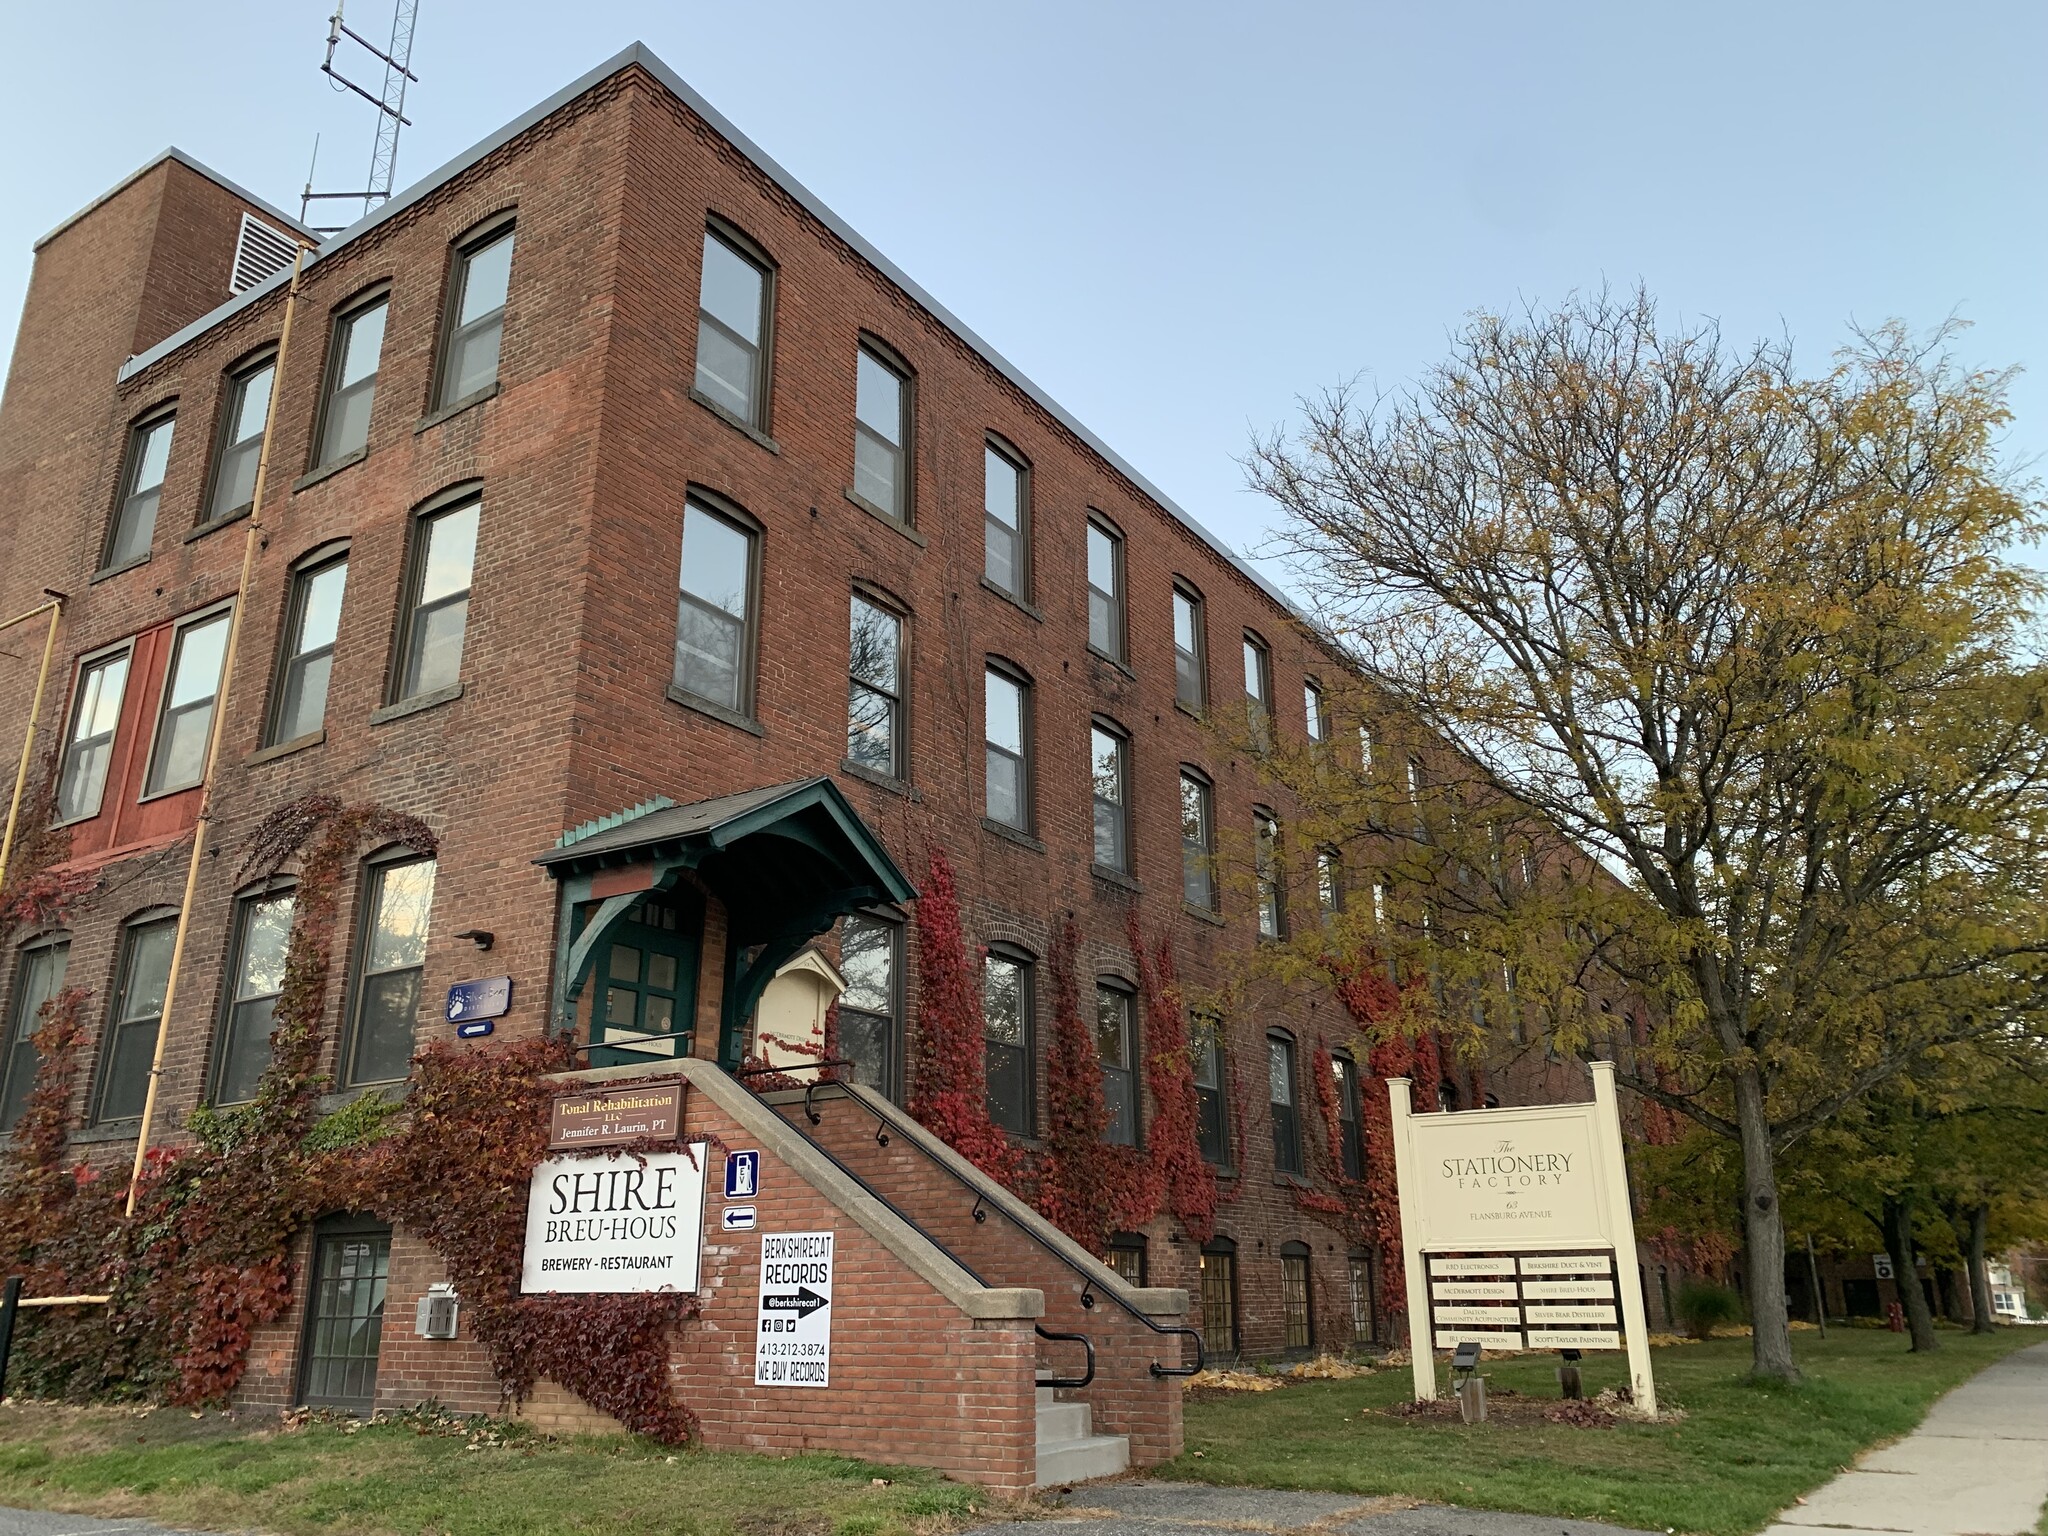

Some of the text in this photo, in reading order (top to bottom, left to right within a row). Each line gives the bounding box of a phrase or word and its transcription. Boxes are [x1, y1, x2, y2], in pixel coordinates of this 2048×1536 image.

[560, 1094, 672, 1115] Tonal Rehabilitation
[604, 1112, 623, 1122] LLC
[560, 1119, 667, 1140] Jennifer R. Laurin, PT
[1493, 1140, 1515, 1154] The
[1442, 1152, 1573, 1178] STATIONERY
[1458, 1173, 1562, 1189] FACTORY
[549, 1167, 677, 1215] SHIRE
[1506, 1200, 1518, 1210] 63
[1470, 1210, 1552, 1221] FLANSBURG AVENUE
[544, 1215, 677, 1243] BREU-HOUS
[764, 1236, 831, 1259] BERKSHIRECAT
[541, 1257, 592, 1271] BREWERY
[600, 1255, 673, 1270] RESTAURANT
[765, 1263, 828, 1284] RECORDS
[768, 1297, 820, 1308] @berkshirecat1
[1579, 1336, 1613, 1344] PAINTINGS
[760, 1343, 825, 1356] 413-212-3874
[758, 1361, 769, 1381] WE
[772, 1361, 787, 1381] BUY
